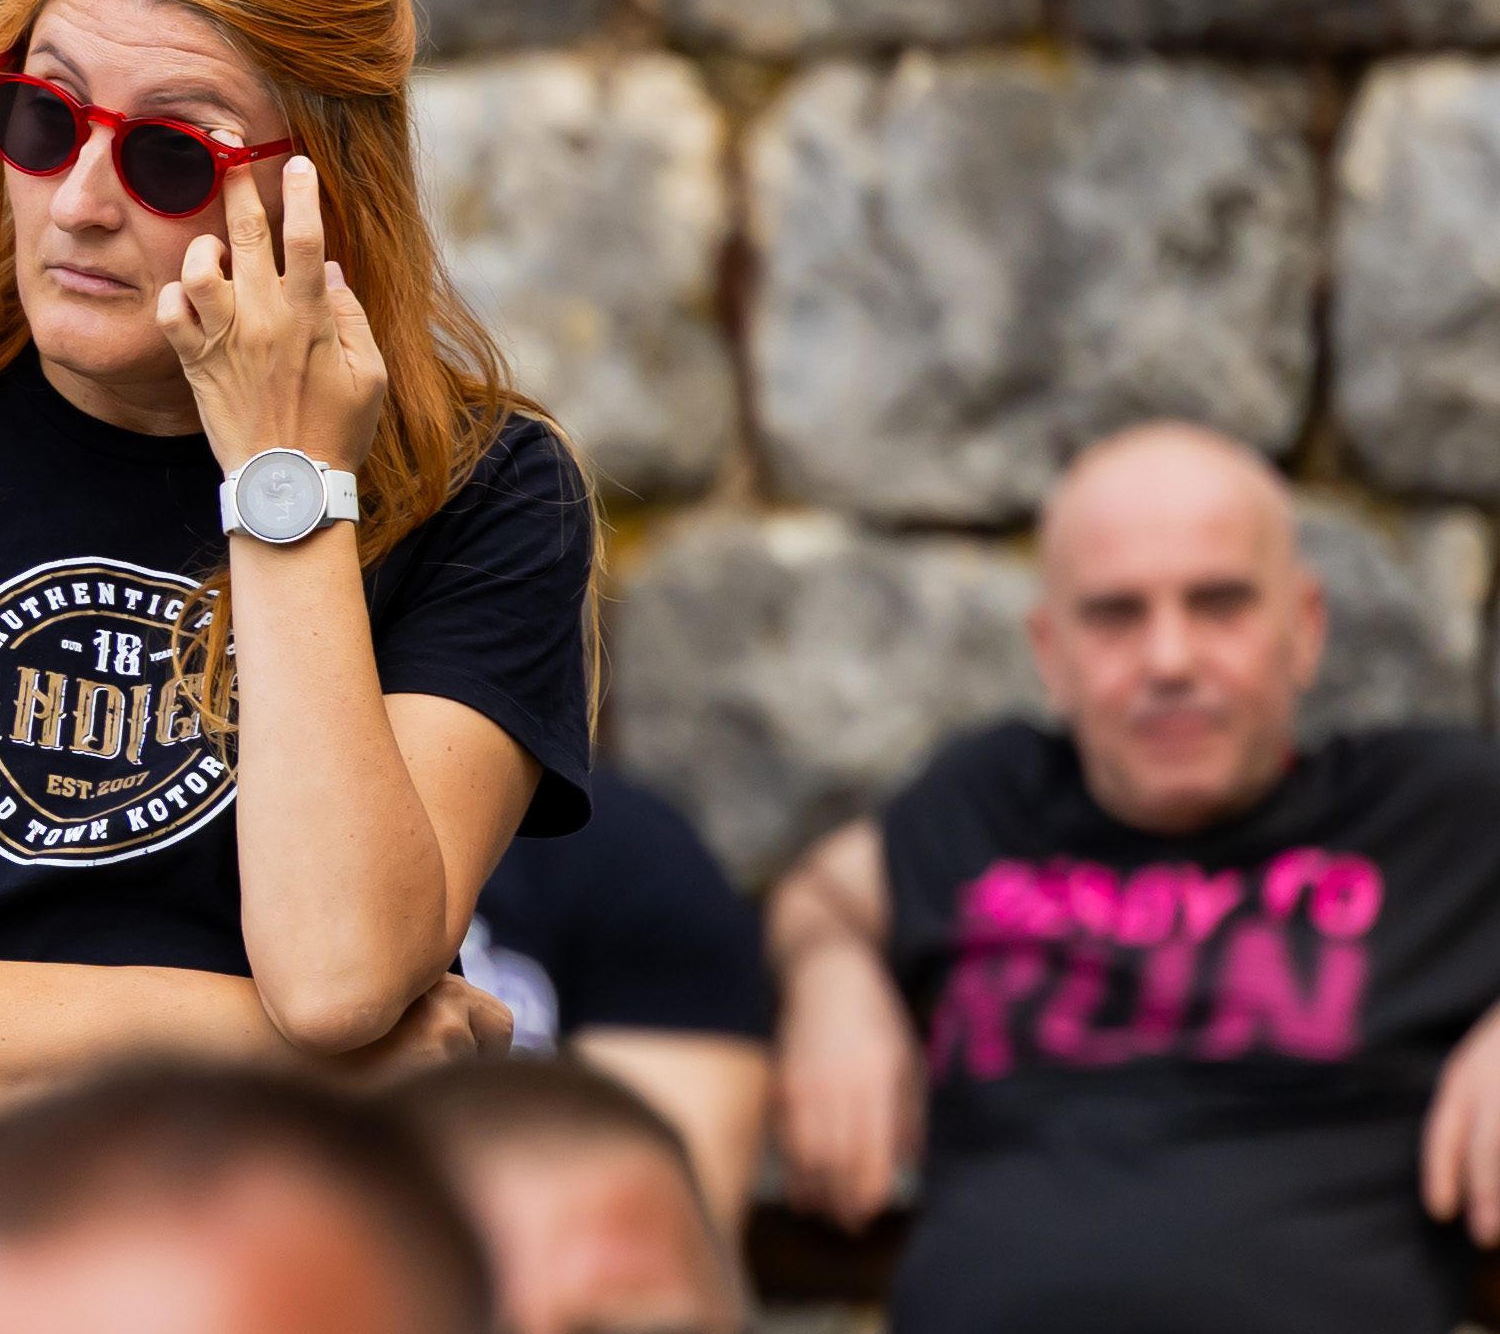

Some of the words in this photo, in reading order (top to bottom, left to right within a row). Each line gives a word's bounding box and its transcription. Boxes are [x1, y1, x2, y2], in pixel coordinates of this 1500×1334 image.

[61, 639, 83, 653] OUR
[93, 629, 143, 676] 18
[24, 818, 109, 846] TOWN
[126, 754, 225, 832] KOTOR
